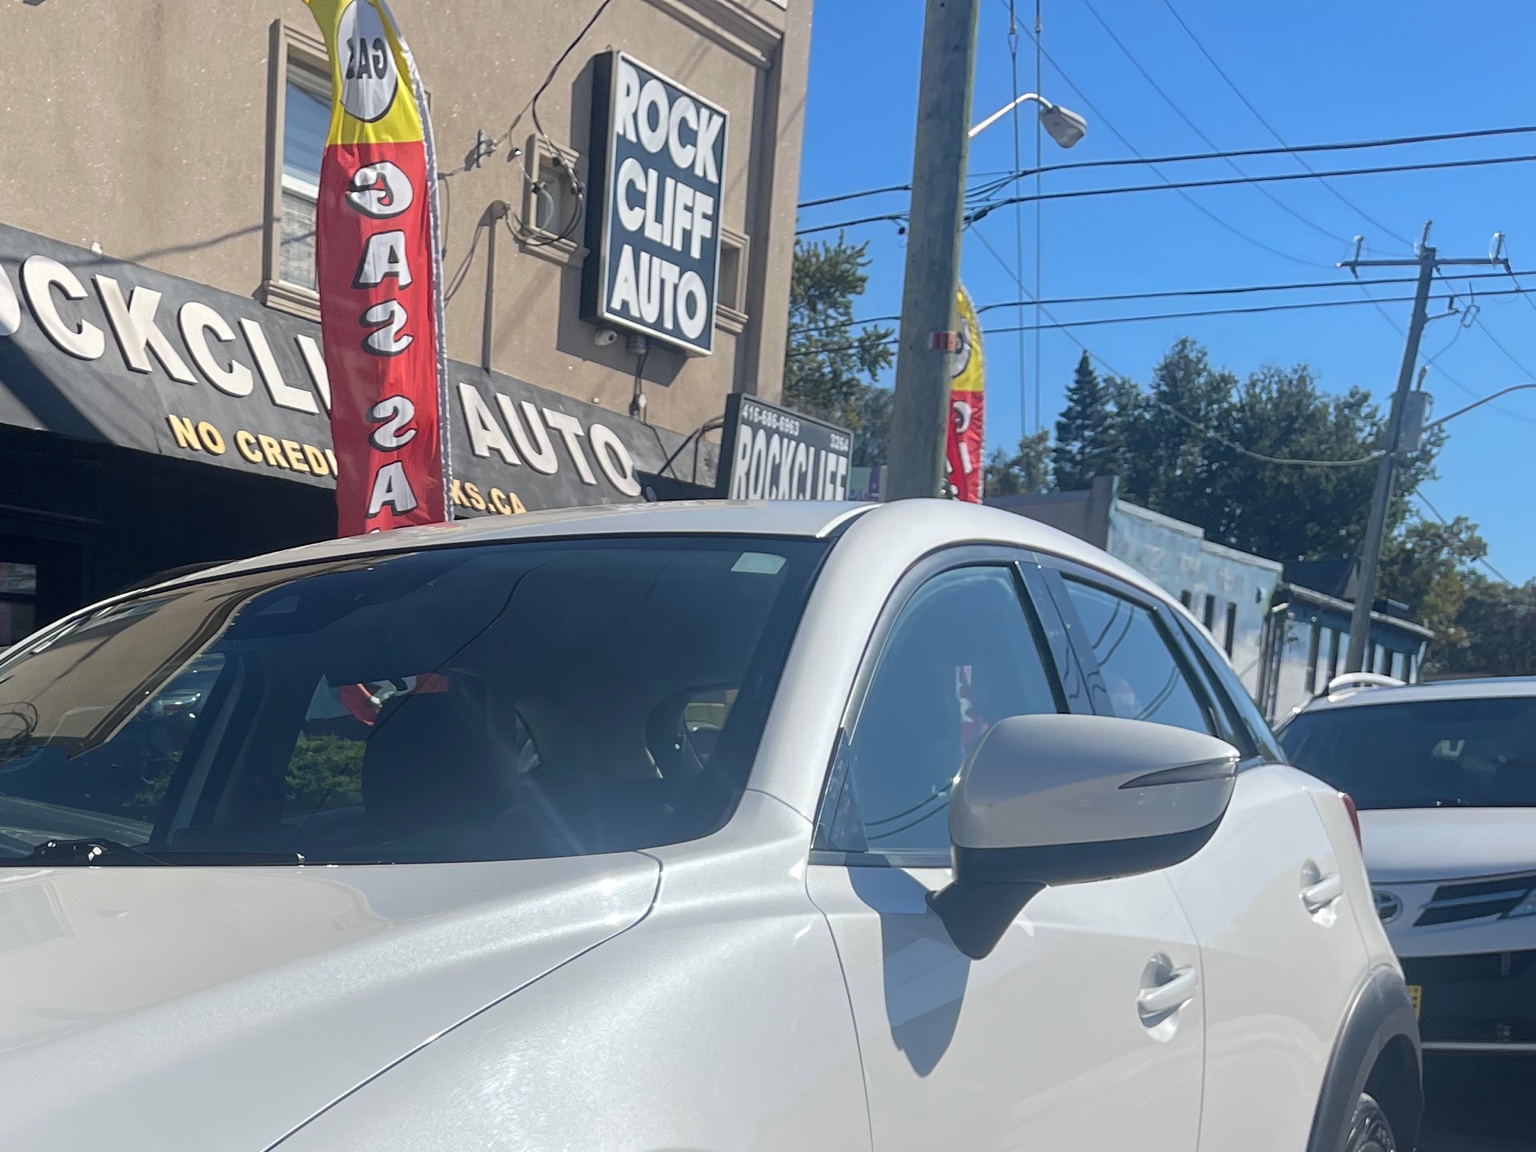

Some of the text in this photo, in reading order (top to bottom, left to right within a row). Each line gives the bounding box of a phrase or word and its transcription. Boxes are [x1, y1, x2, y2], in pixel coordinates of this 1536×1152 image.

[617, 64, 724, 184] ROCK
[617, 157, 715, 259] CLIFF
[610, 244, 708, 340] AUTO
[168, 414, 227, 456] NO
[235, 430, 338, 477] CREDI
[459, 382, 642, 497] AUTO
